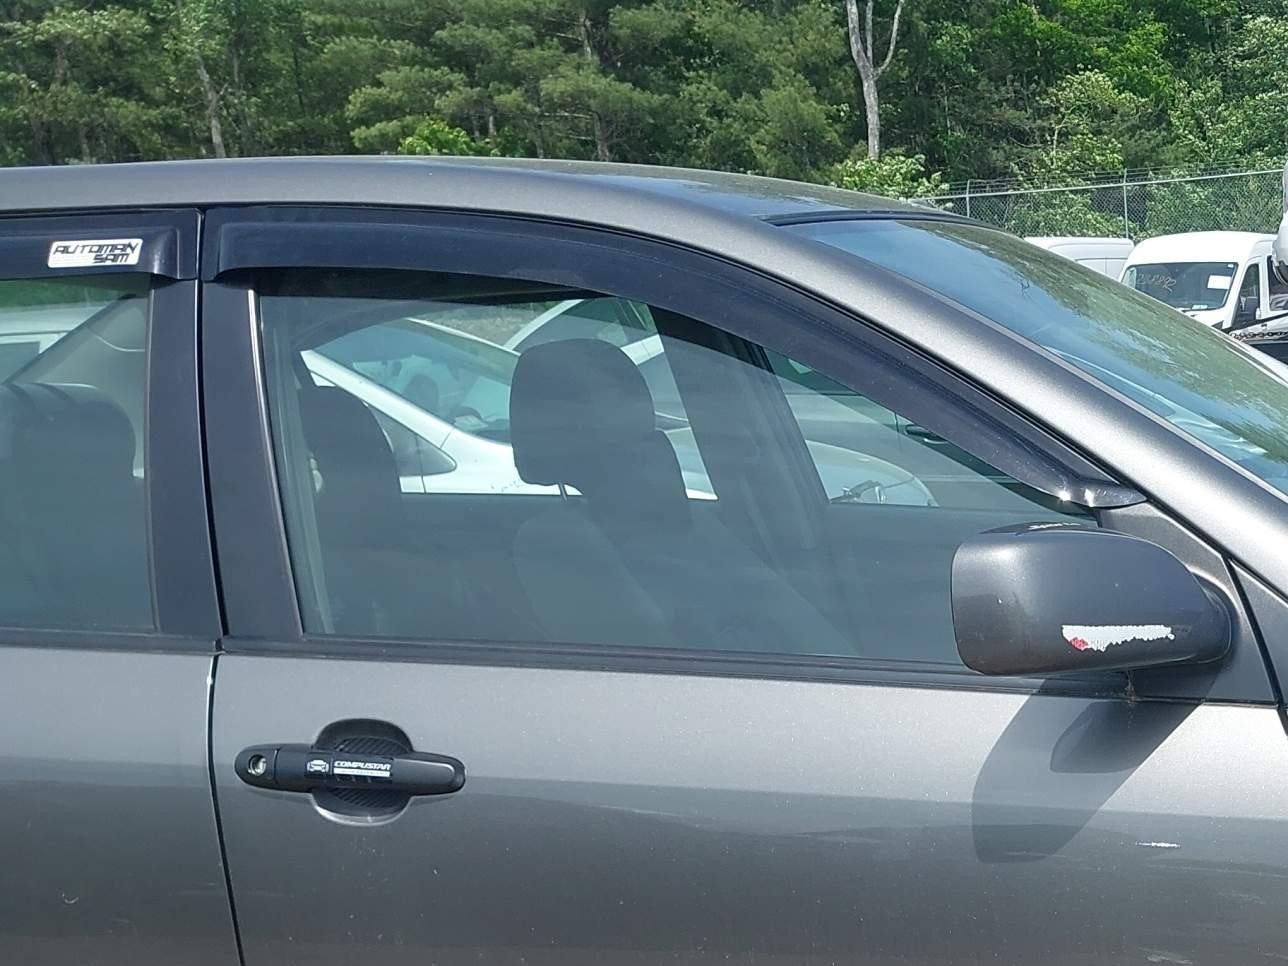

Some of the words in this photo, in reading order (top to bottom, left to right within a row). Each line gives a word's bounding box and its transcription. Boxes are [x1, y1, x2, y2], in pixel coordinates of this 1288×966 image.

[53, 242, 138, 255] AUTOMAN
[92, 253, 129, 264] SAM
[334, 761, 391, 770] COMPUSTAR
